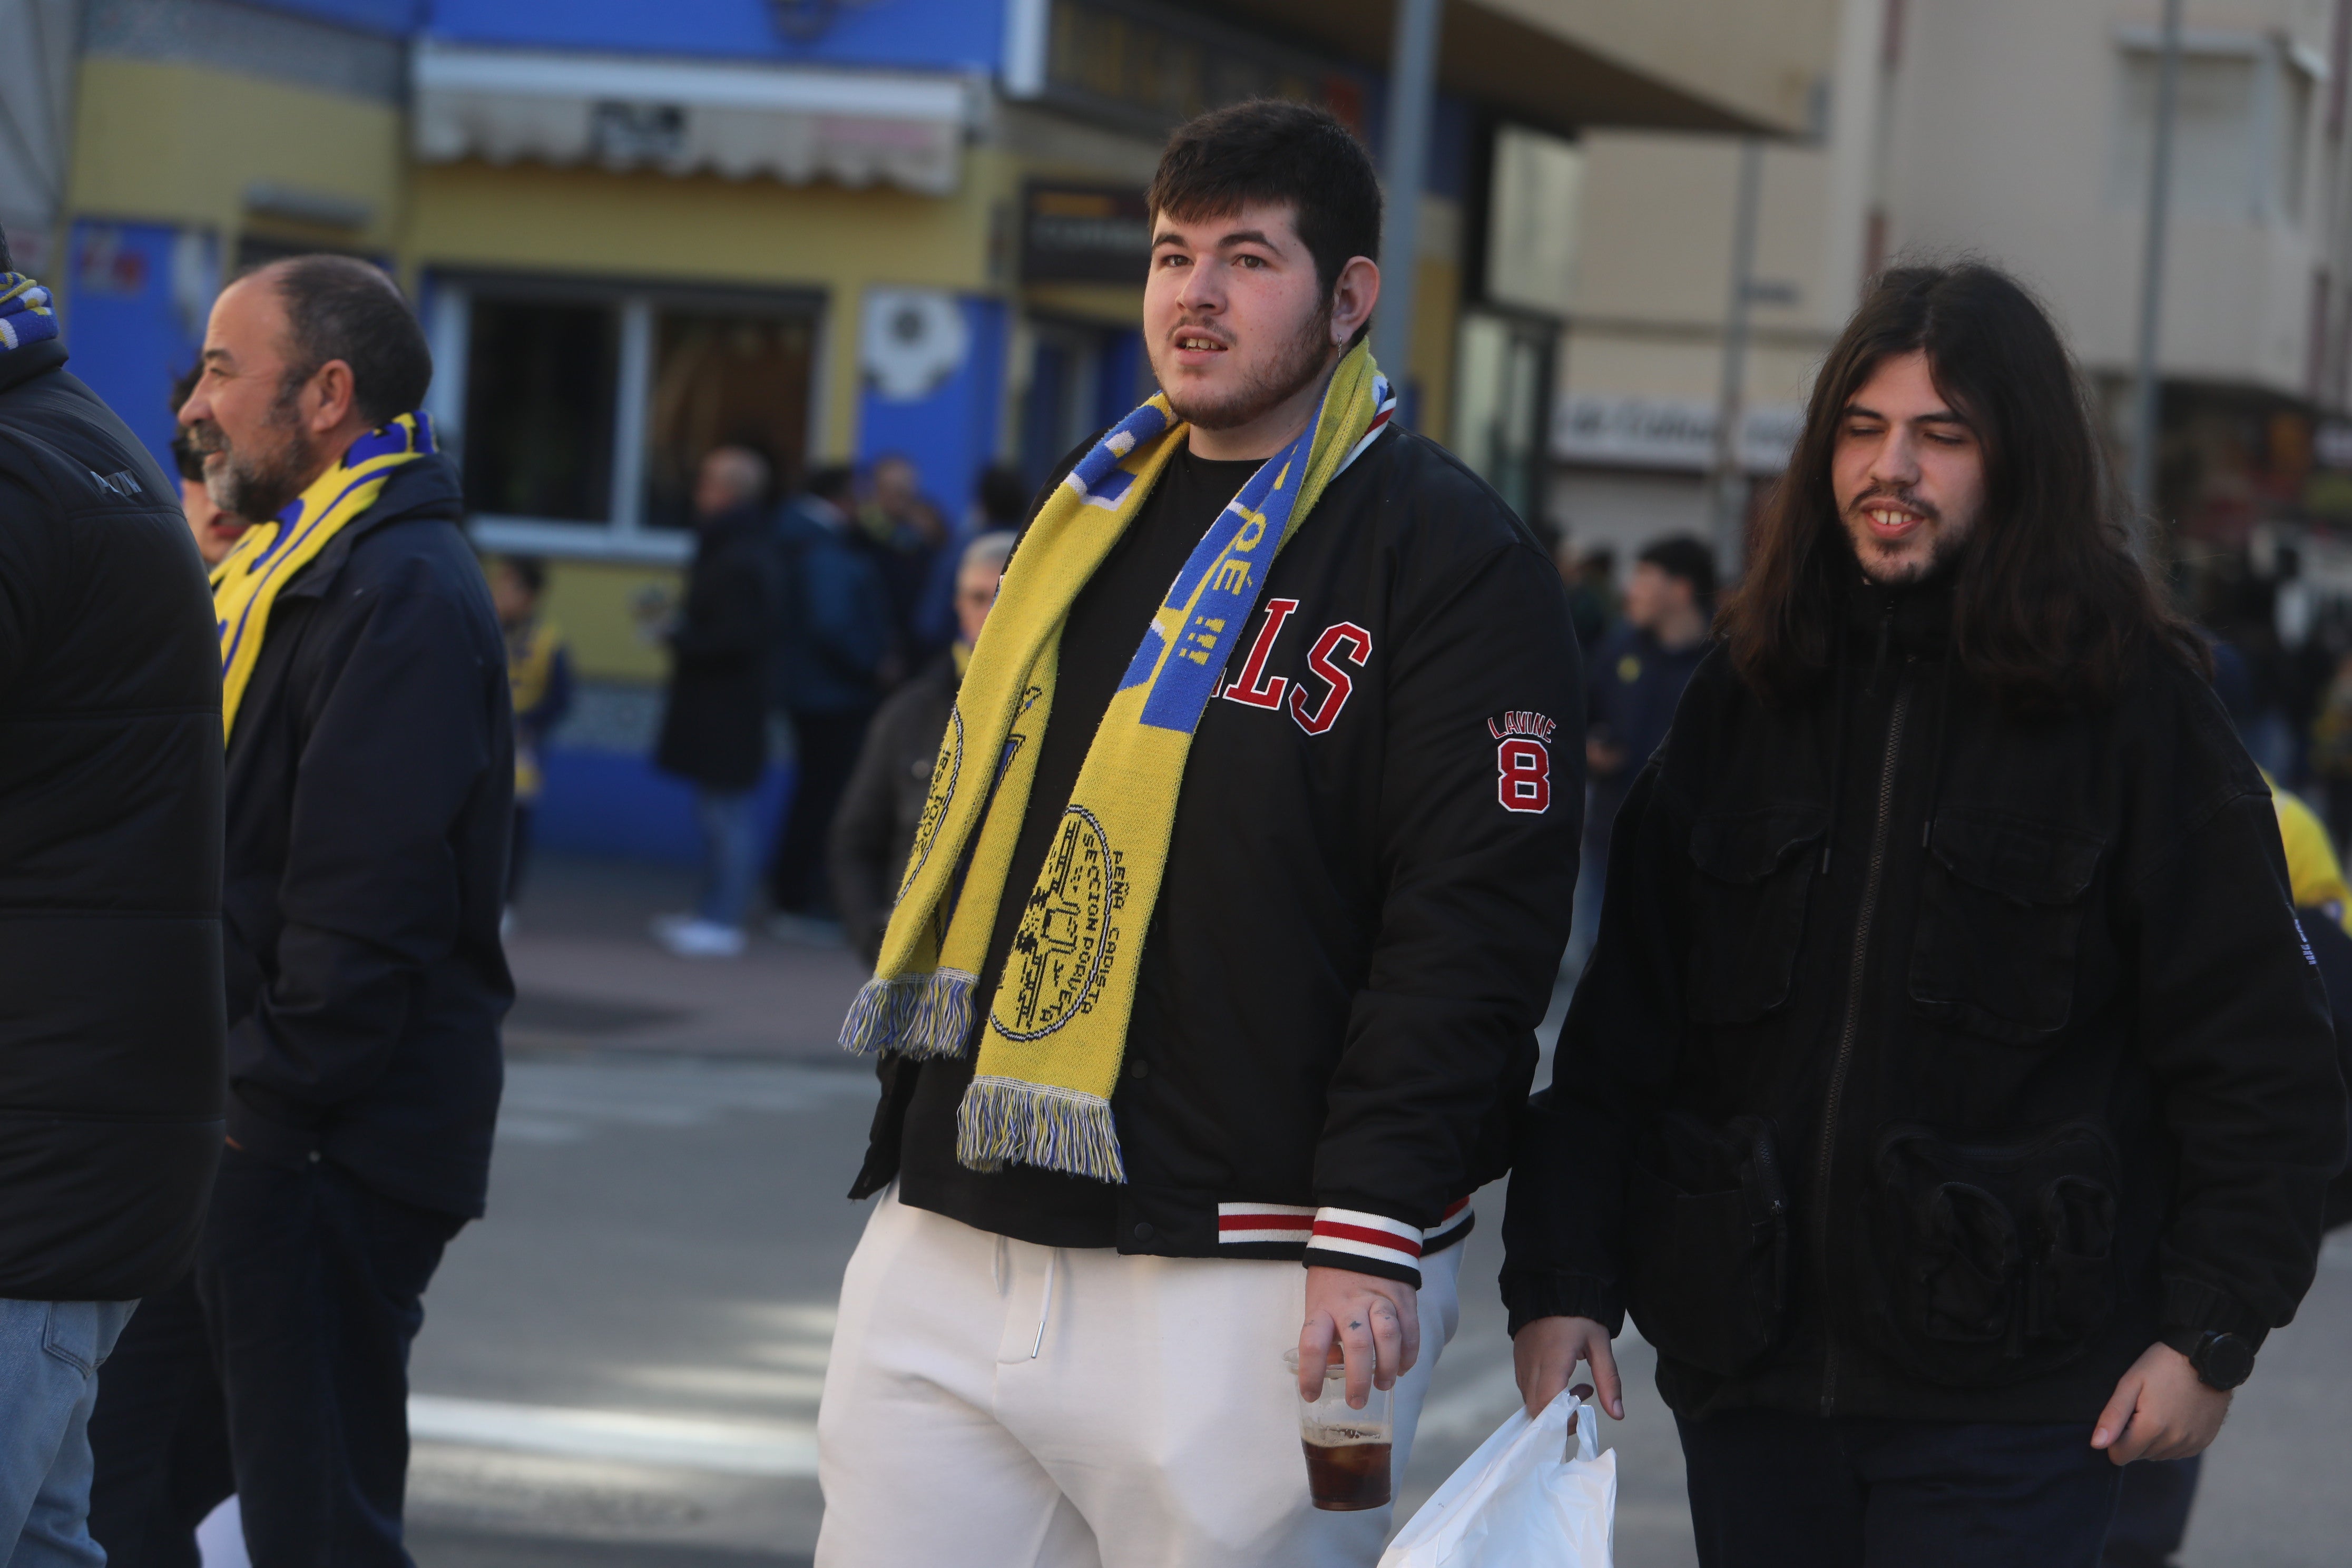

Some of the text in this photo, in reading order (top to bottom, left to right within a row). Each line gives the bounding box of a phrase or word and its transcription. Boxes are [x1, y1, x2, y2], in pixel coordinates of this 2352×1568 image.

[1487, 711, 1556, 743] LAVINE
[1498, 738, 1550, 814] 8
[916, 795, 945, 855] 2001
[1083, 832, 1101, 932] SECCION
[1080, 850, 1130, 1014] PEÑA CADISTA
